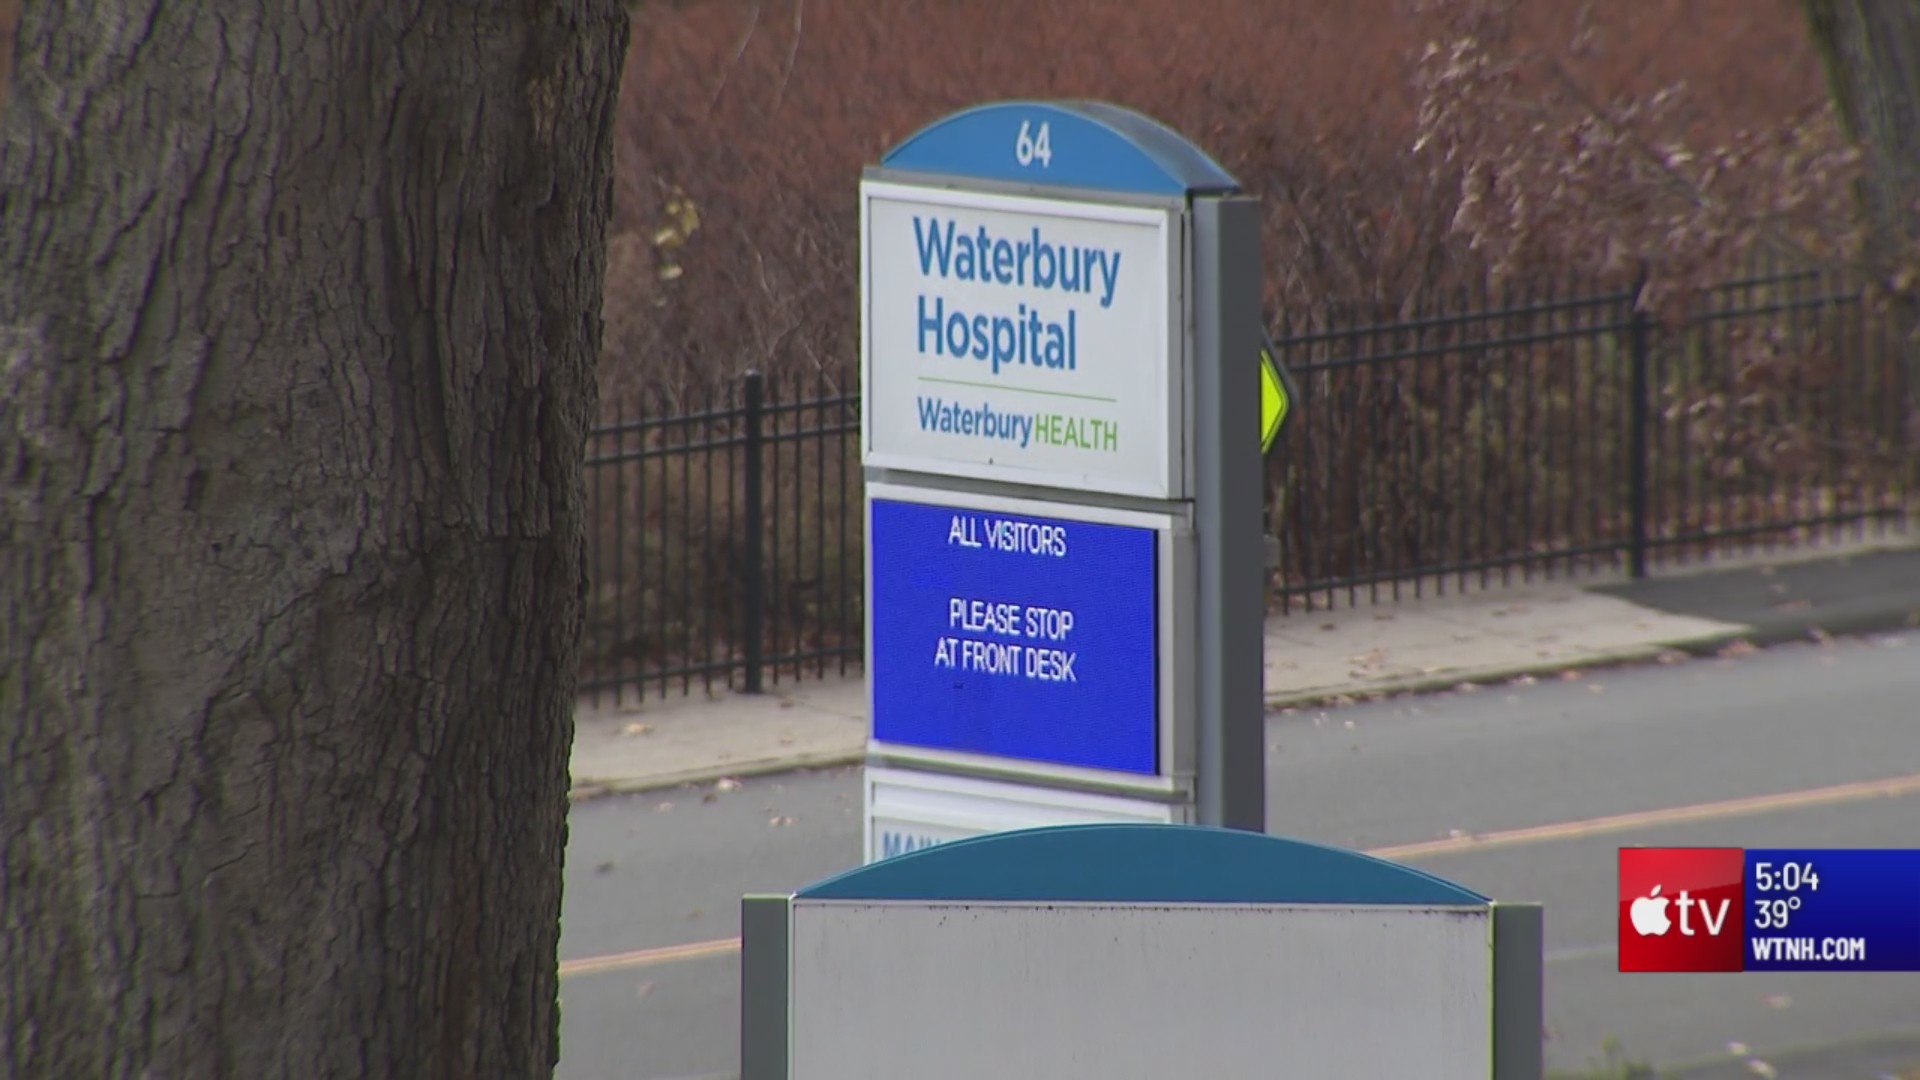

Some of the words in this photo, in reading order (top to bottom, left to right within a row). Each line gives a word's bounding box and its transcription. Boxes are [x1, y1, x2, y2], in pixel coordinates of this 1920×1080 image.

[1016, 120, 1052, 168] 64
[913, 216, 1121, 308] Waterbury
[917, 295, 1077, 375] Hospital
[949, 515, 982, 547] ALL
[984, 519, 1067, 557] VISITORS
[950, 598, 1020, 636] PLEASE
[1025, 606, 1073, 640] STOP
[934, 636, 959, 670] AT
[962, 640, 1021, 675] FRONT
[1025, 647, 1077, 682] DESK
